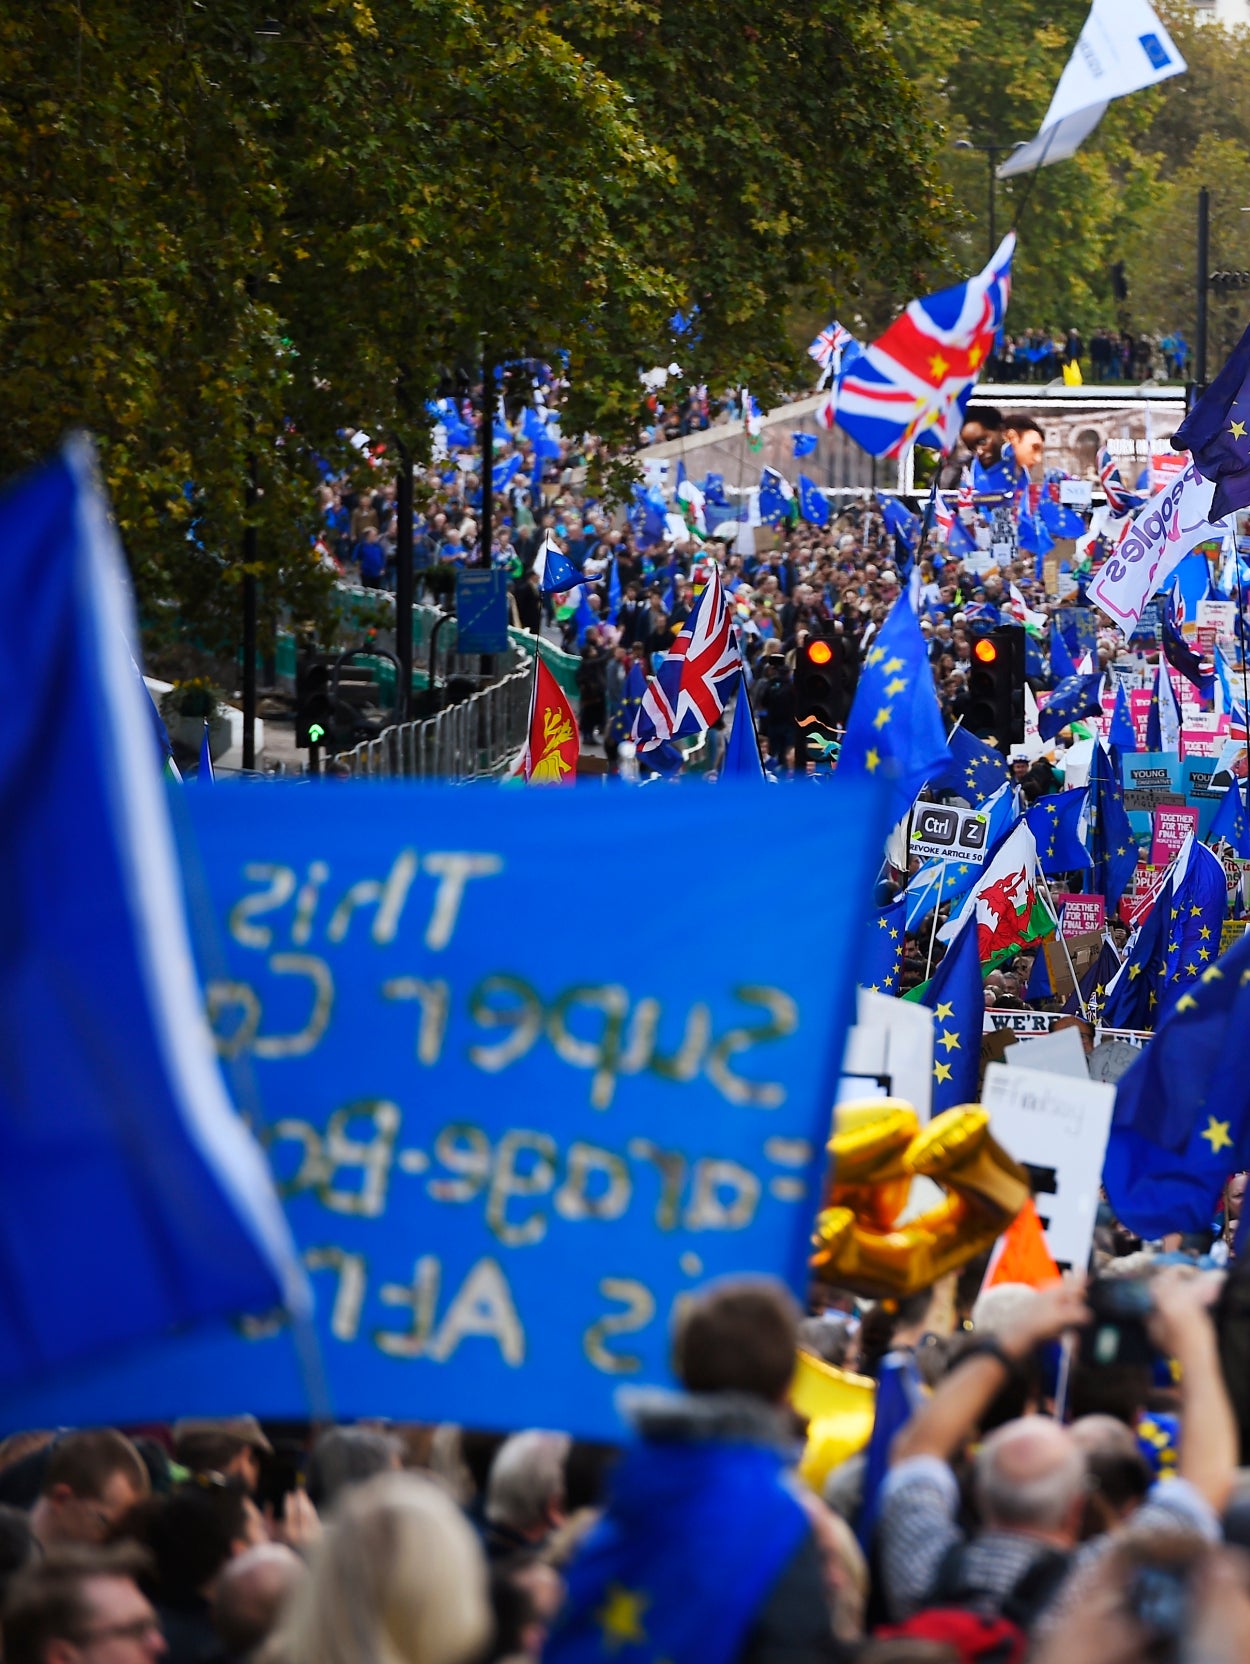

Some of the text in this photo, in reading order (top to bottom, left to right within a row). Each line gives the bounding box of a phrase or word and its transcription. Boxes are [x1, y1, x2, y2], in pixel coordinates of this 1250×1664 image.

[1132, 769, 1166, 779] YOUNG
[1191, 773, 1213, 782] YOU
[1160, 813, 1194, 824] TOGETHER
[924, 817, 978, 840] Ctrl Z
[1161, 822, 1191, 831] FOR THE
[1158, 830, 1178, 840] FINAL
[909, 843, 983, 862] REVOKE ARTICLE 50
[1066, 911, 1097, 921] FOR THE
[1063, 920, 1100, 931] FINAL SAY
